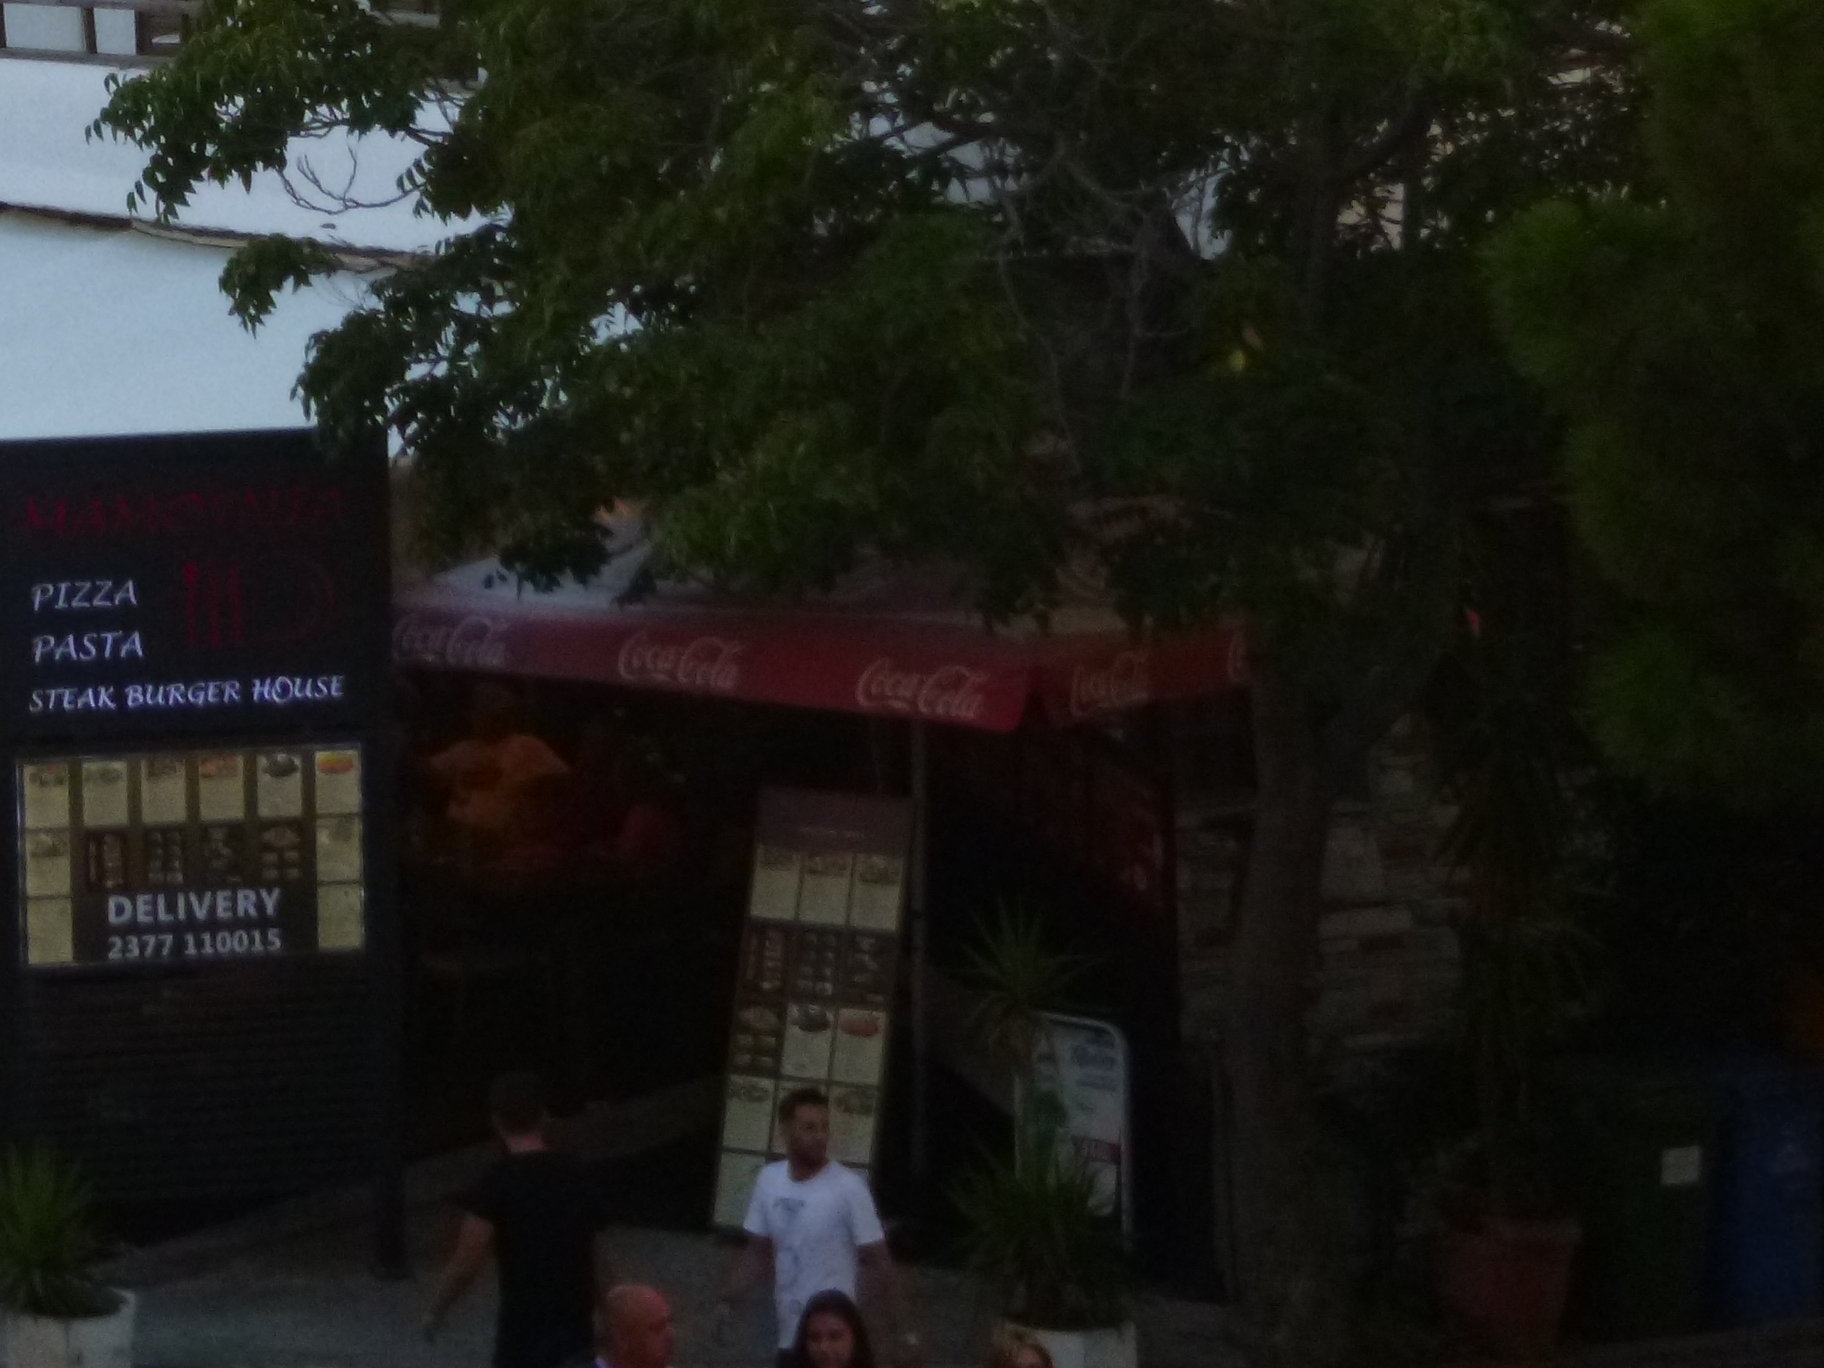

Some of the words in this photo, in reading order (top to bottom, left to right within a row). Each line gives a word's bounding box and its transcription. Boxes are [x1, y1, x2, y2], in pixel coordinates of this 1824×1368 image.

[31, 578, 138, 612] PIZZA
[33, 630, 144, 664] PASTA
[617, 630, 744, 691] Coca-Cola
[29, 686, 117, 712] STEAK
[125, 679, 240, 708] BURGER
[252, 674, 345, 703] HOUSE
[855, 658, 991, 719] Coca-Cola
[107, 888, 280, 925] DELIVERY
[108, 933, 173, 960] 2377
[184, 928, 282, 955] 110015
